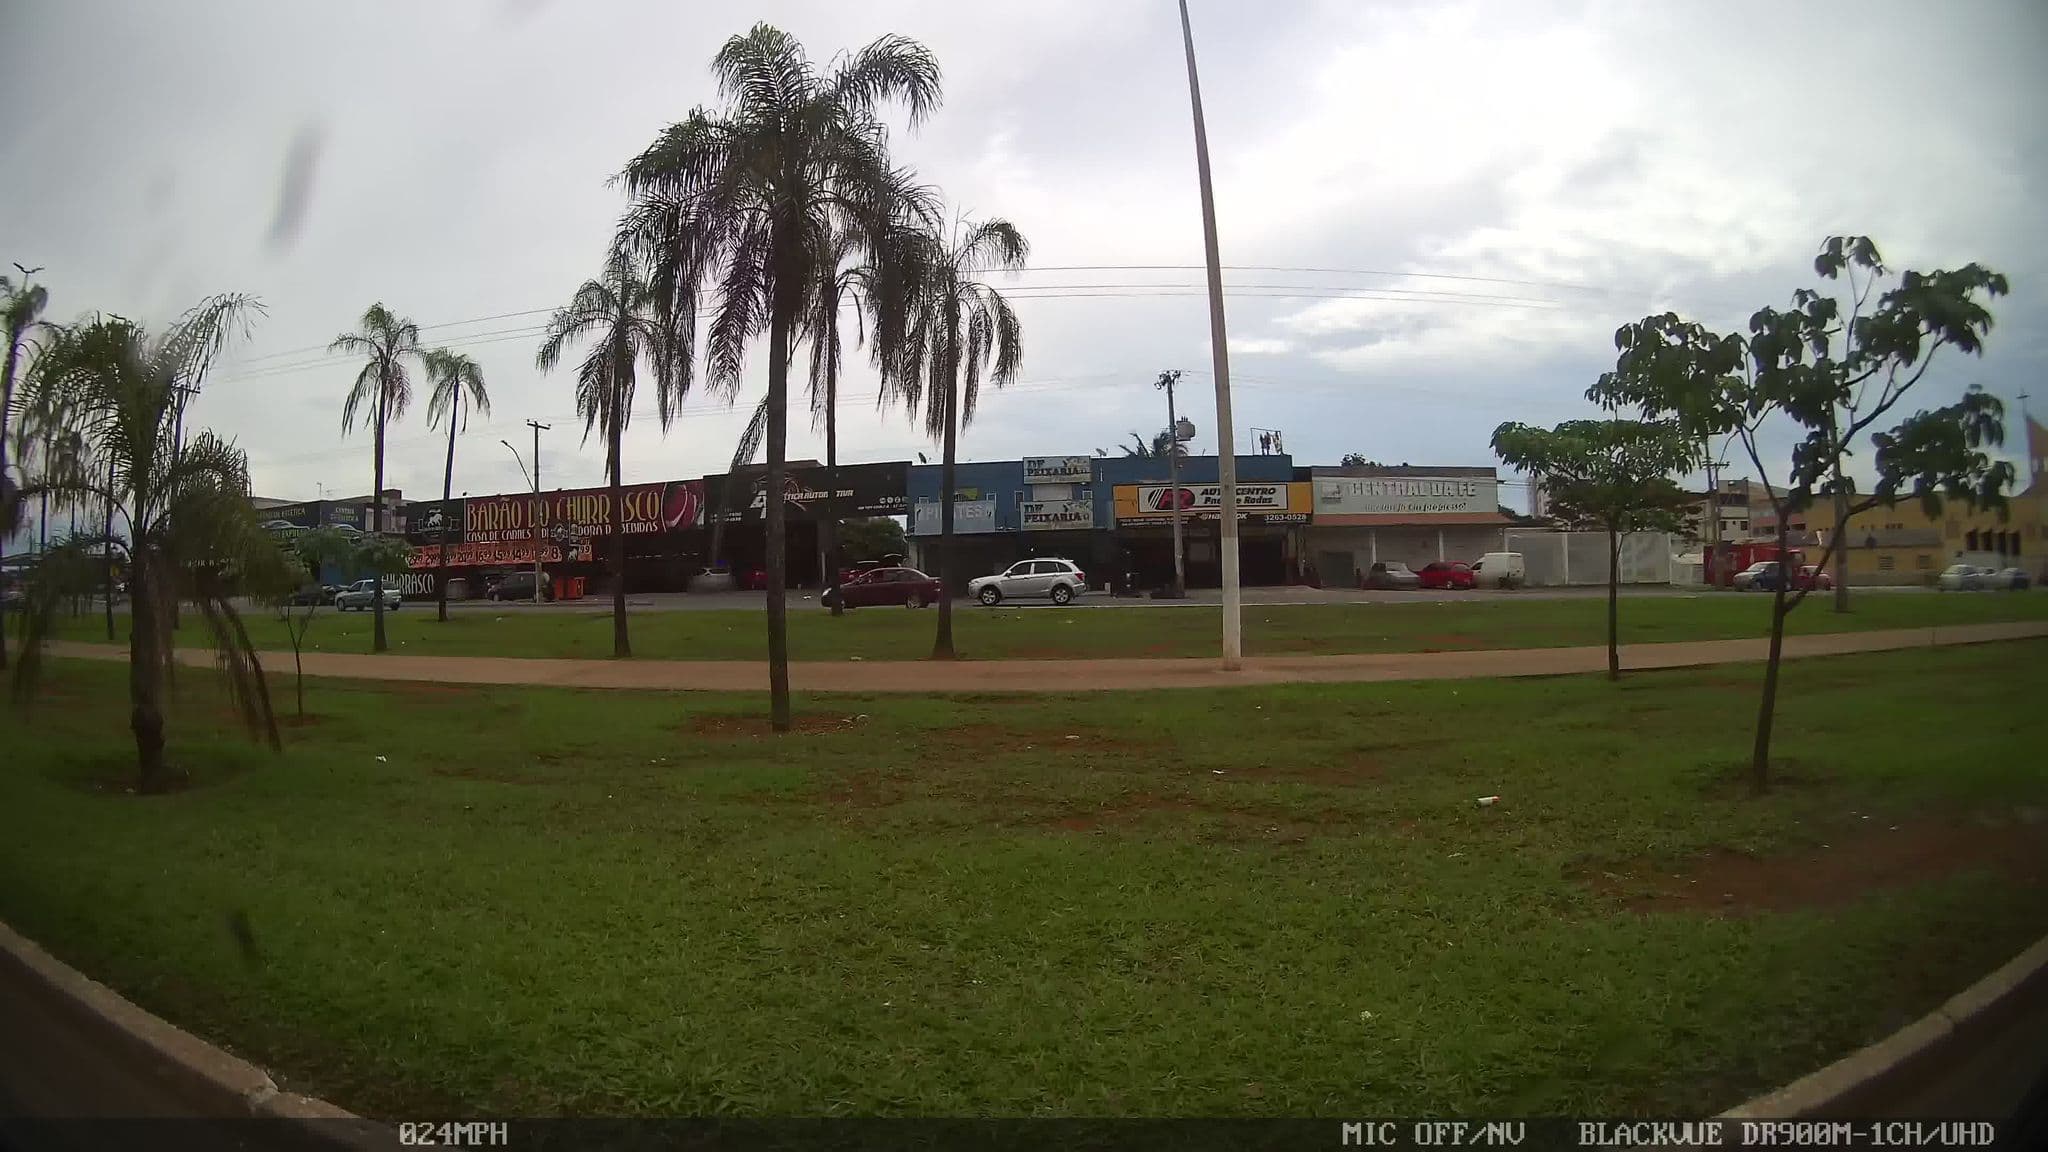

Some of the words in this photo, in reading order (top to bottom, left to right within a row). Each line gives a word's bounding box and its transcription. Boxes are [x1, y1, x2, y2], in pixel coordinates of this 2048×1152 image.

[1027, 468, 1079, 477] PEIXARIA
[1200, 488, 1221, 496] AUT
[1236, 488, 1277, 496] CENTRO
[1352, 481, 1427, 497] CENTRAL
[1431, 481, 1456, 497] DA
[1204, 496, 1221, 505] Pne
[1243, 496, 1273, 505] Rodas
[466, 496, 522, 532] BARÃO
[527, 499, 550, 529] DO
[1024, 513, 1084, 524] PEIXARIA
[466, 531, 488, 542] CASA
[489, 530, 499, 541] DE
[501, 528, 532, 541] CARNES
